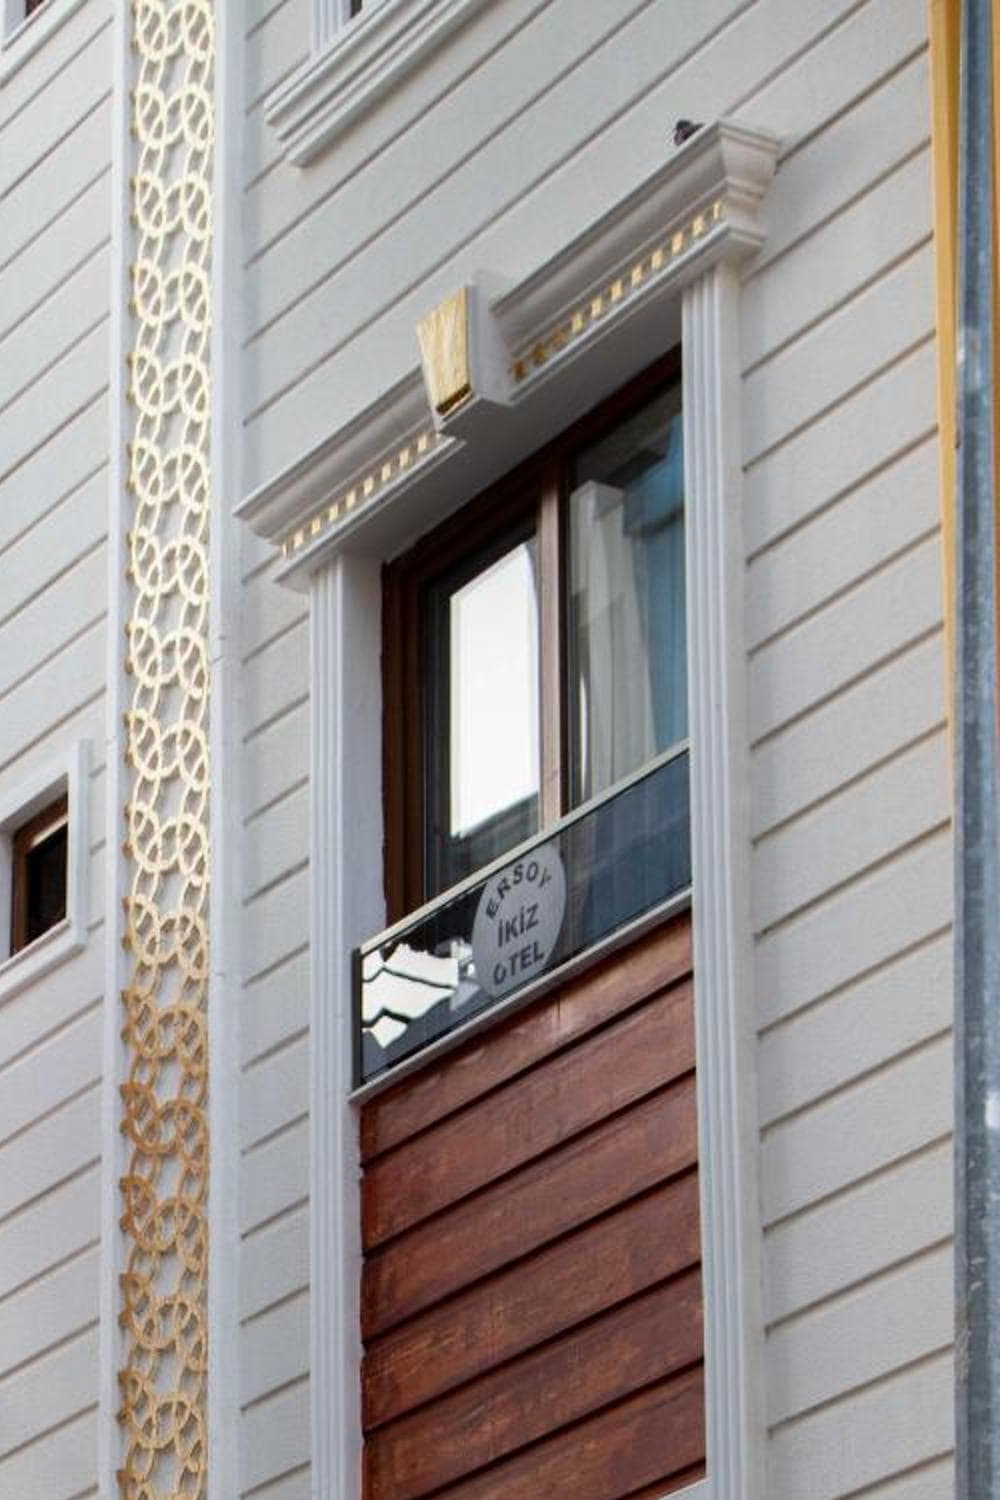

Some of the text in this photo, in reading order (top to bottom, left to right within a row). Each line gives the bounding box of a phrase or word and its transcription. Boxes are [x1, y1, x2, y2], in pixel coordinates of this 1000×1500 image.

[485, 861, 551, 921] ERSOY
[498, 903, 540, 948] İKİZ
[492, 940, 545, 986] OTEL
